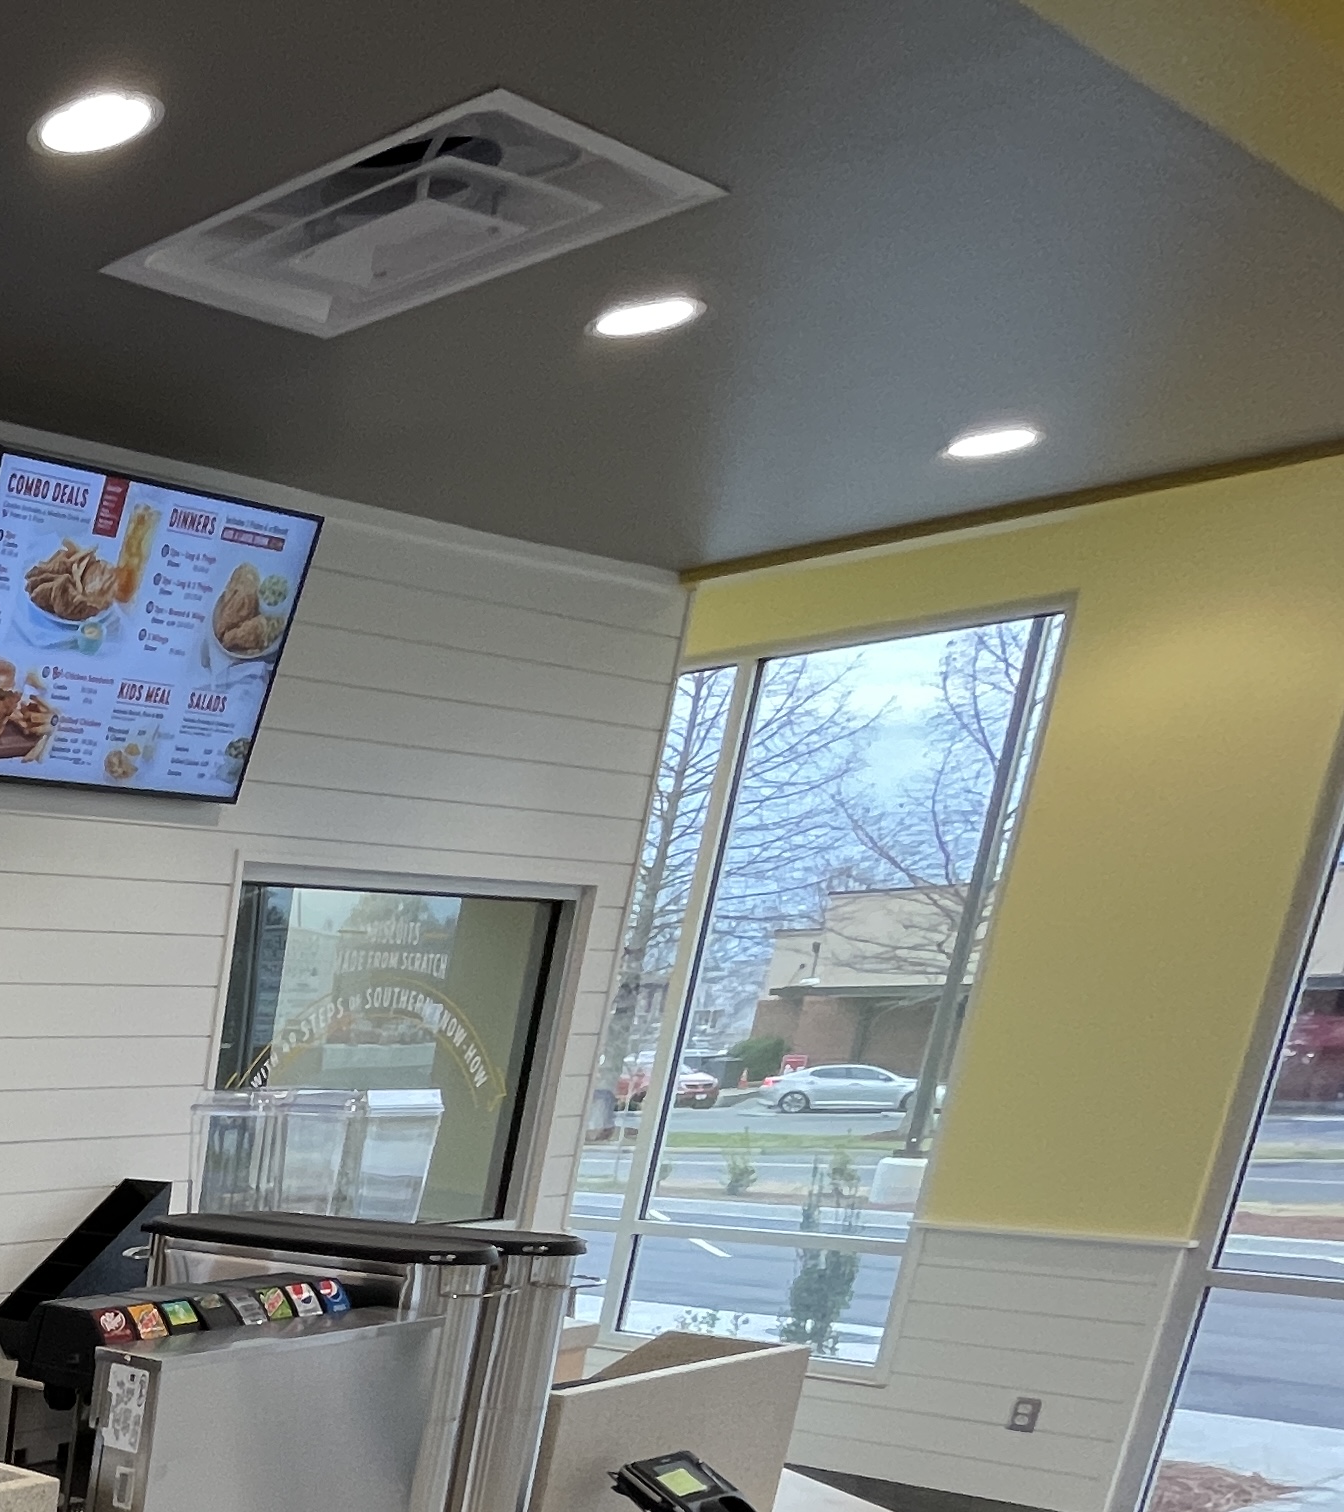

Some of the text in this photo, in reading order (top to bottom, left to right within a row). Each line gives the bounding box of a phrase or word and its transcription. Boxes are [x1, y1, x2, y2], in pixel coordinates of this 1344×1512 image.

[7, 473, 50, 500] COMBO
[51, 482, 89, 508] DEALS
[169, 508, 217, 536] DINNERS
[117, 681, 172, 706] KIDS MEAL
[187, 692, 228, 713] SALADS
[366, 951, 400, 970] FROM
[401, 952, 449, 980] SCRATCH
[300, 997, 344, 1042] STEPS
